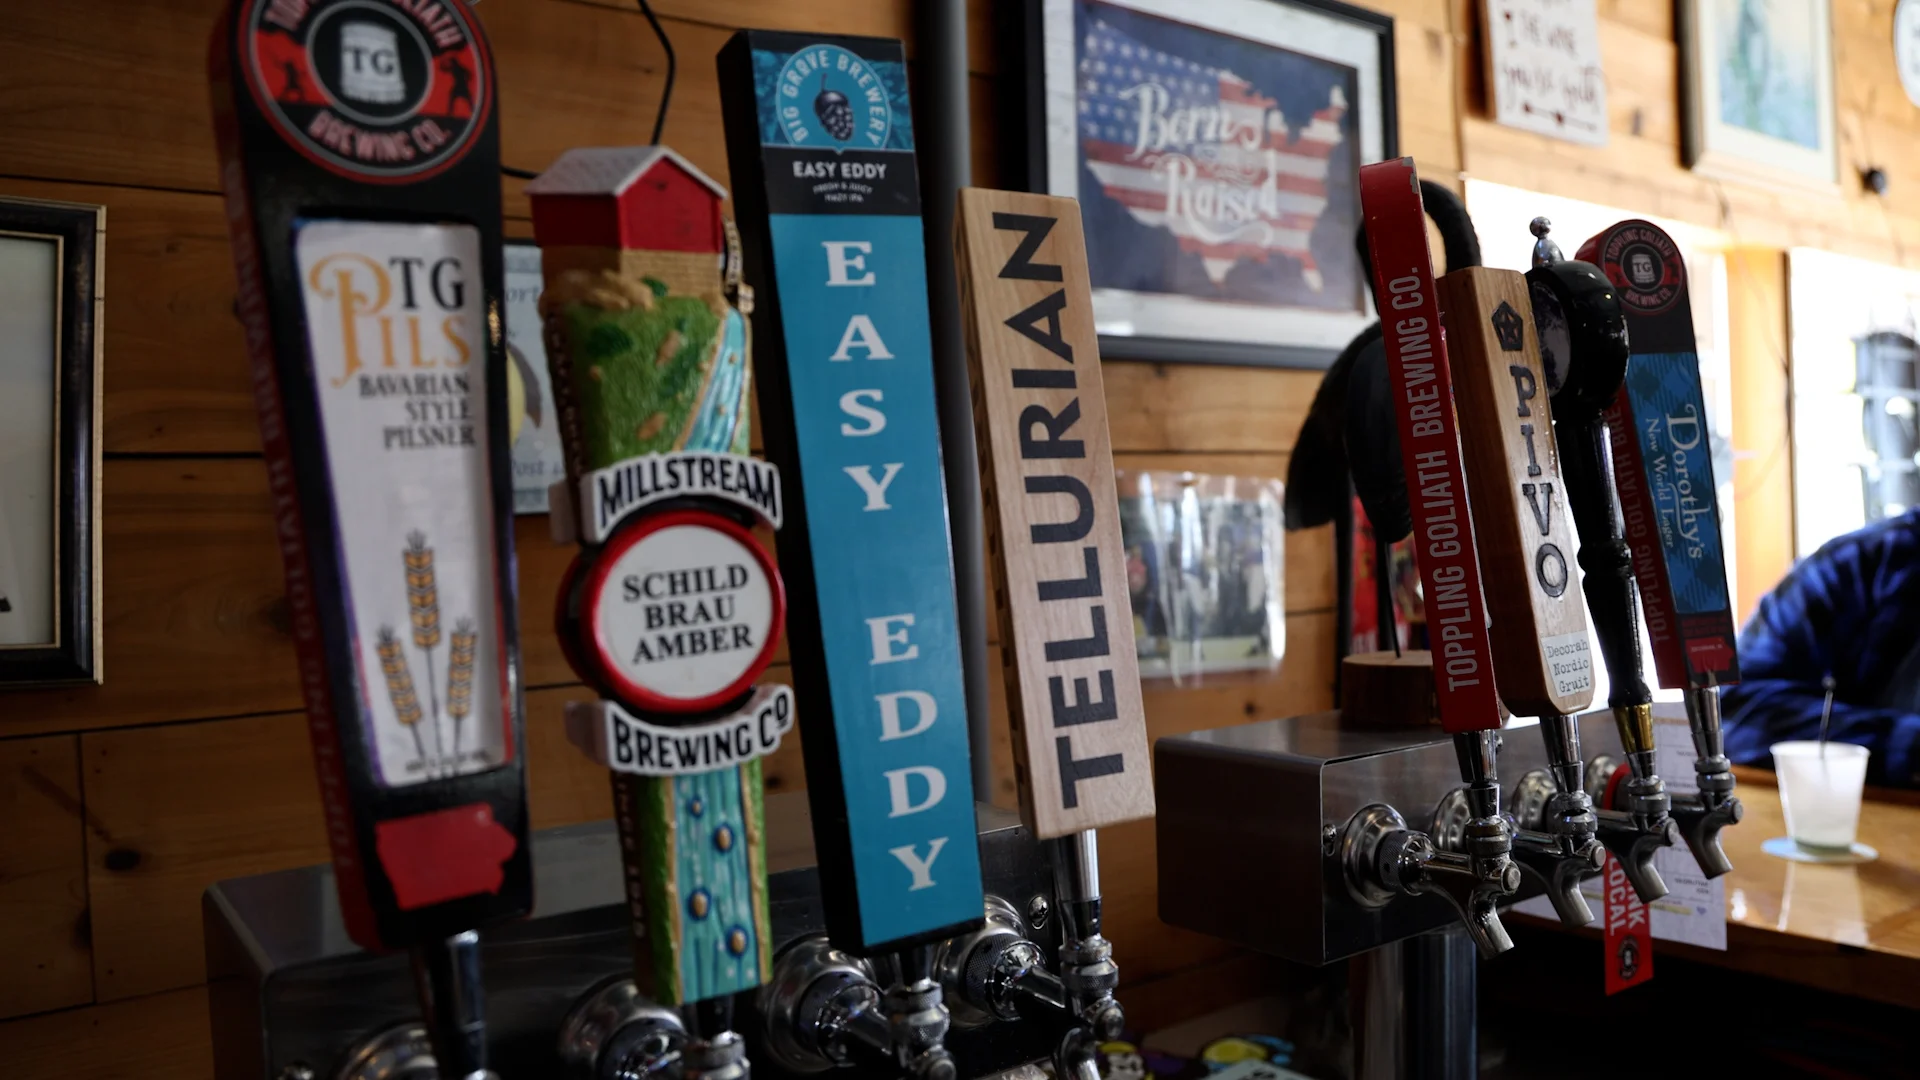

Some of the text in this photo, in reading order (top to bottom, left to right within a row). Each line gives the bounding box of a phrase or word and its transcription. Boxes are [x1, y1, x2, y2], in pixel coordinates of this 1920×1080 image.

[348, 48, 394, 74] TG
[782, 50, 886, 146] BIG GROVE BREWERY
[1118, 82, 1262, 161] Born
[792, 160, 887, 180] EASY EDDY
[1144, 149, 1281, 247] Raised
[389, 257, 465, 311] TG
[1634, 262, 1651, 273] TG
[309, 252, 471, 389] PILS
[358, 372, 471, 397] BAVARIAN
[405, 401, 474, 424] STYLE
[383, 425, 476, 451] PILSNER
[598, 455, 779, 528] MILLSTREAM
[990, 210, 1126, 810] TELLURIAN
[1388, 266, 1480, 693] TOPPLING GOLIATH BREWING CO.
[1509, 364, 1569, 599] PIVO
[1614, 451, 1648, 540] GOLIATH
[1645, 417, 1674, 549] New World Lager
[1666, 403, 1712, 559] Dorothy's
[622, 563, 750, 602] SCHILD
[821, 240, 950, 892] EASY EDDY
[1635, 543, 1671, 646] TOPPLING
[632, 624, 754, 666] AMBER
[643, 595, 736, 631] BRAU
[1546, 639, 1589, 659] Decorah
[1552, 658, 1589, 676] Nordic
[1559, 675, 1590, 693] Gruit
[611, 712, 752, 772] BREWING
[1608, 856, 1627, 936] LOCAL
